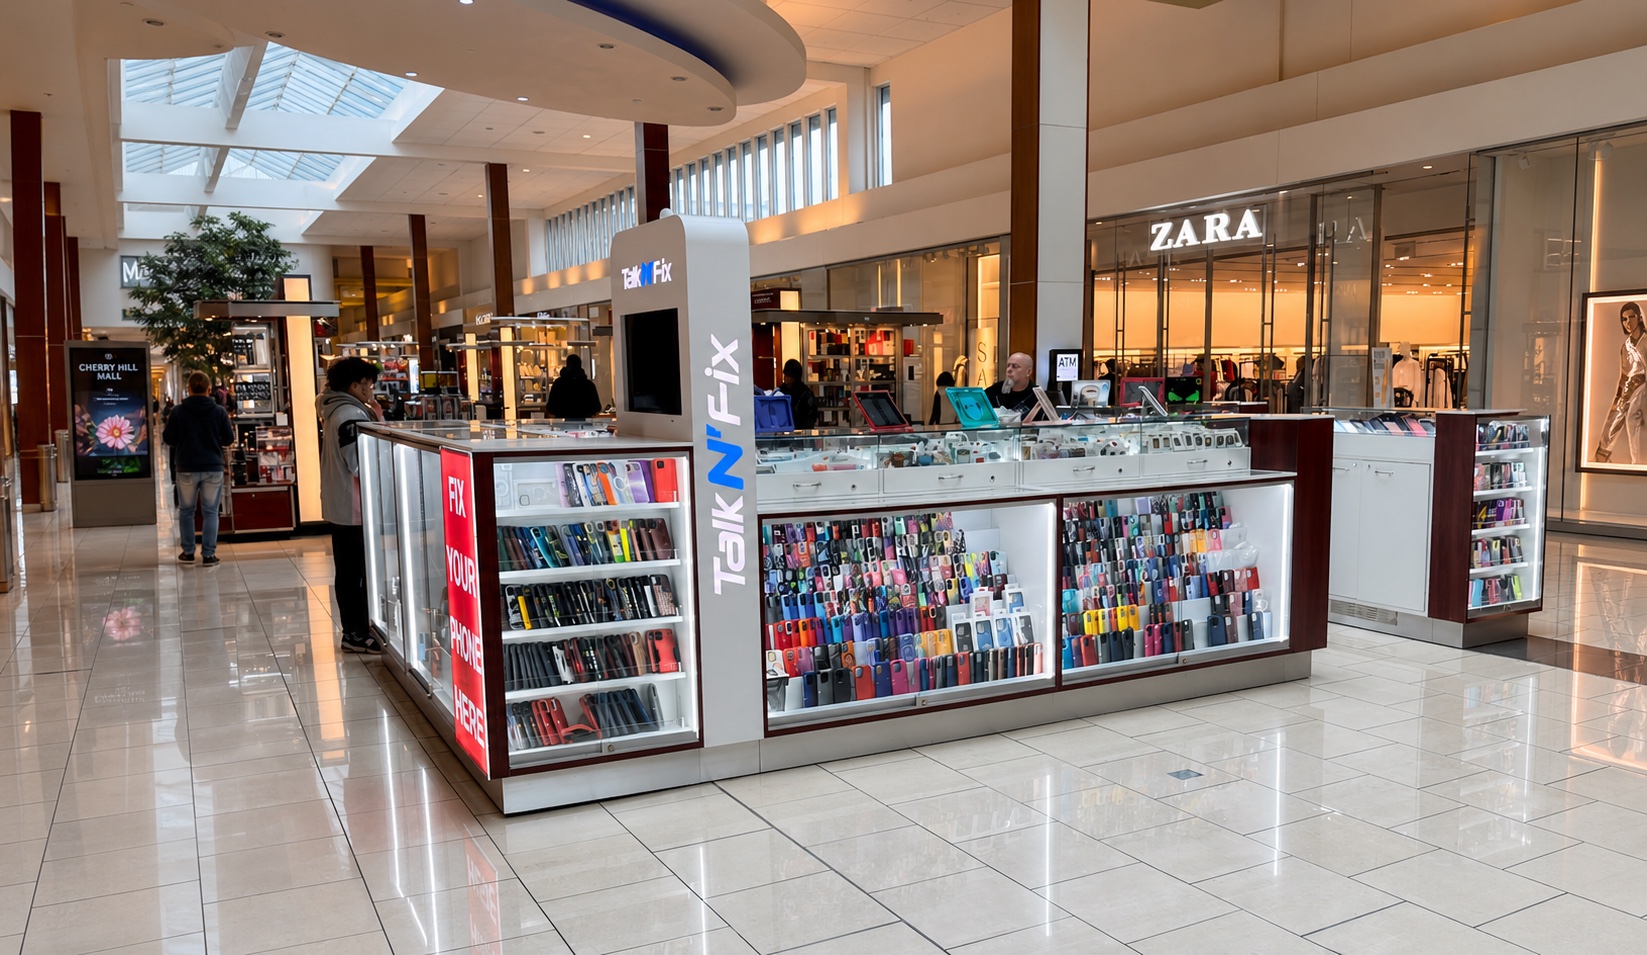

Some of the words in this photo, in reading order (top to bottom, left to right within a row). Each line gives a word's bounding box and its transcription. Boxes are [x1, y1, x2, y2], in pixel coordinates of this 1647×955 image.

[1150, 209, 1263, 251] ZARA
[78, 363, 116, 372] CHERRY
[117, 363, 139, 372] HILL
[96, 372, 122, 380] MALL
[1058, 356, 1077, 368] ATM
[448, 475, 467, 519] FIX
[446, 544, 477, 599] YOUR
[449, 615, 482, 676] PHONE
[454, 684, 485, 749] HERE
